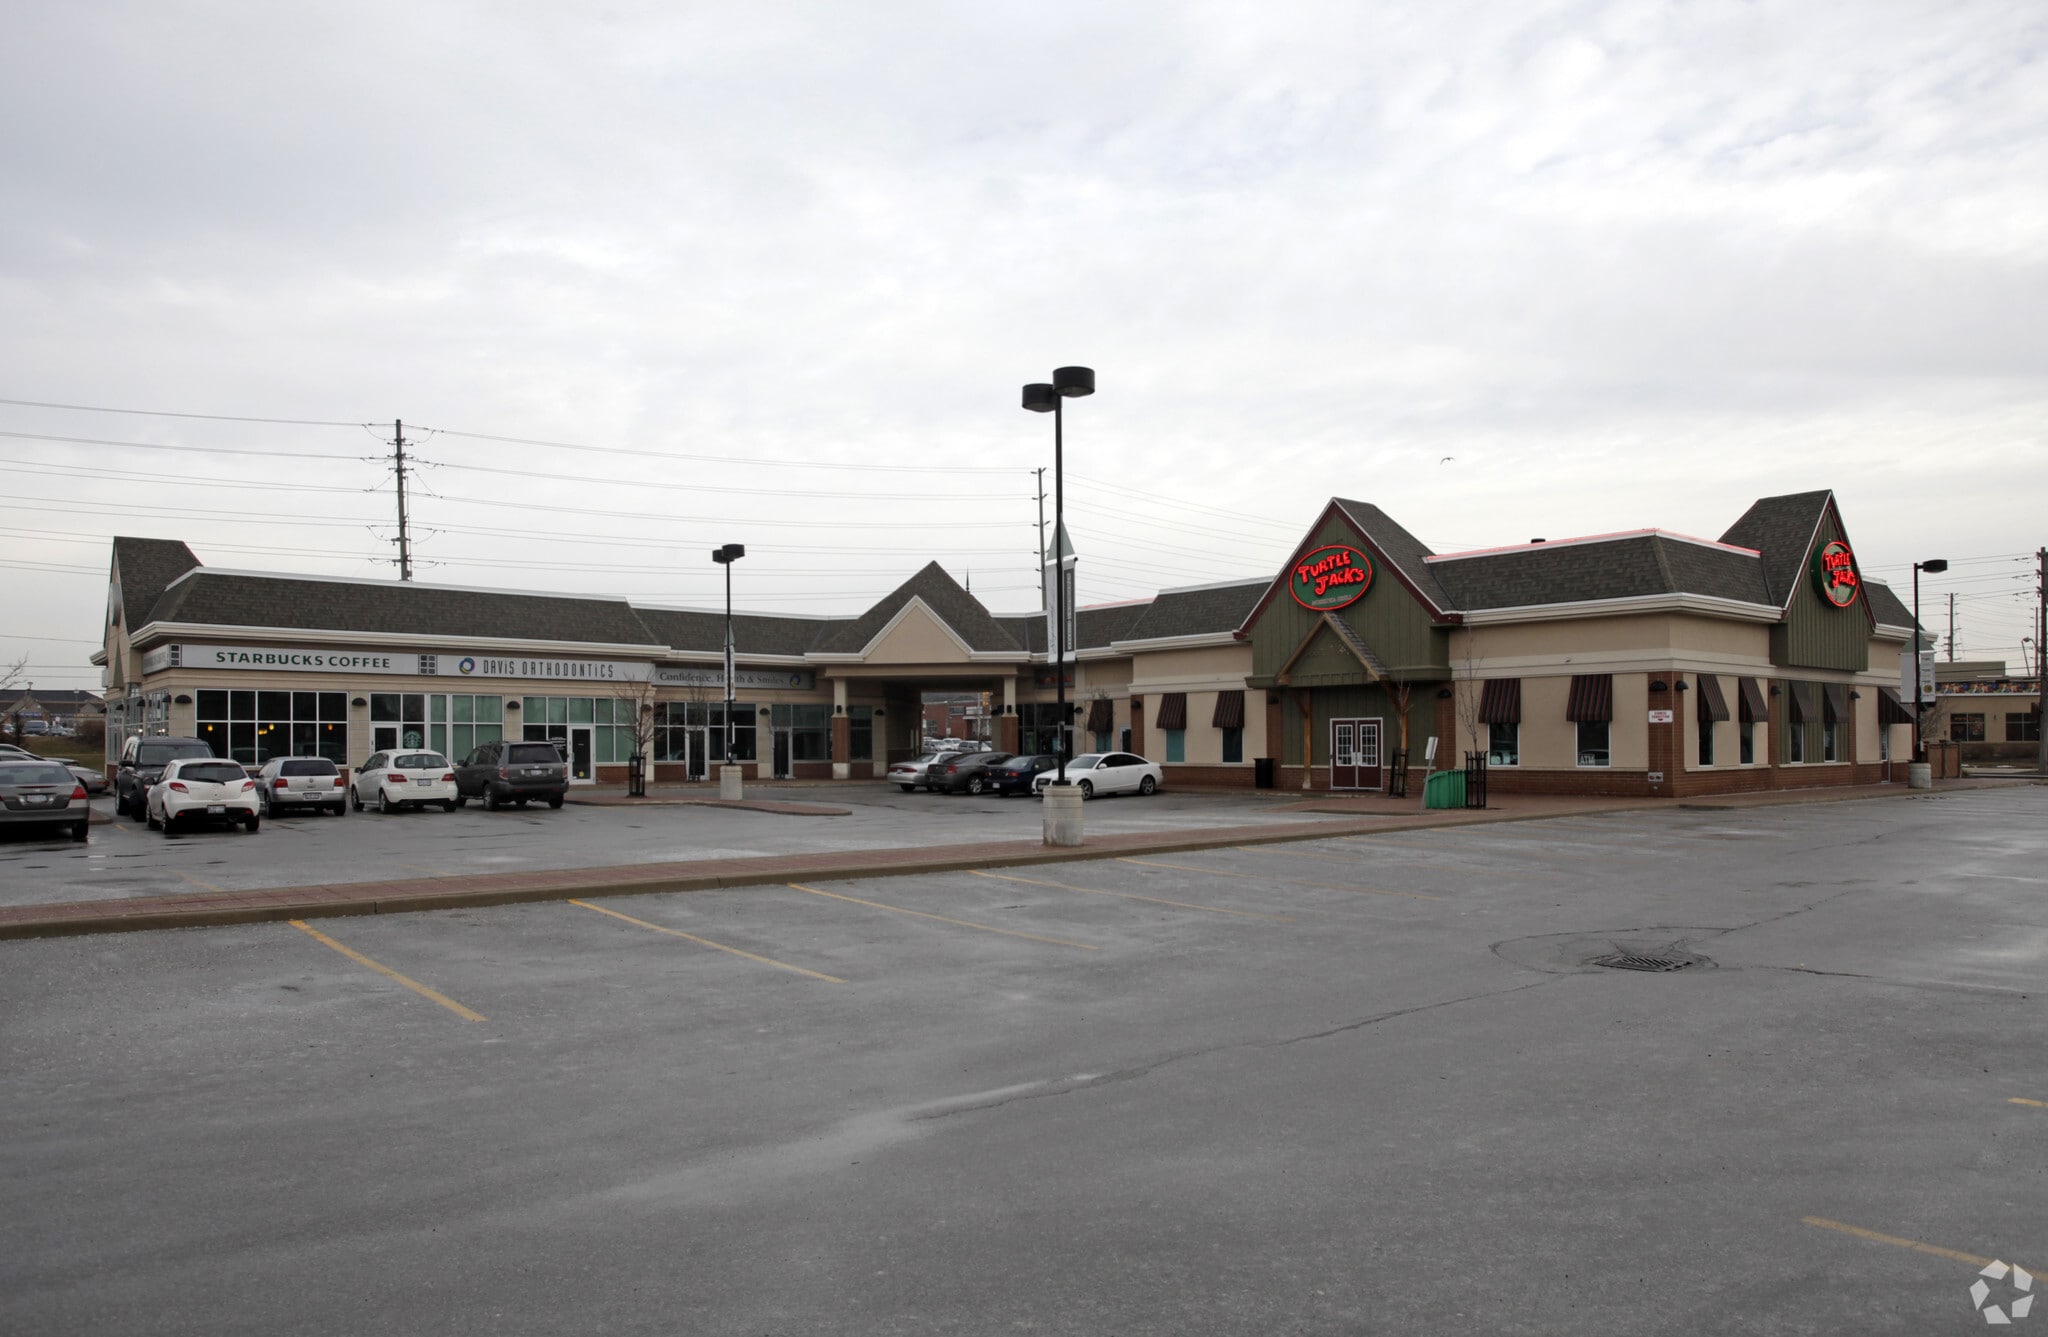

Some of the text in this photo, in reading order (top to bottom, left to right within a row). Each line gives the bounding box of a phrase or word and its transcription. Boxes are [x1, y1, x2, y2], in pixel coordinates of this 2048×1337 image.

[1297, 551, 1351, 584] TURTLE
[1314, 567, 1366, 595] JACK'S
[216, 651, 391, 668] STARBUCKS COFFEE
[747, 675, 754, 683] &
[757, 675, 784, 684] Smiles
